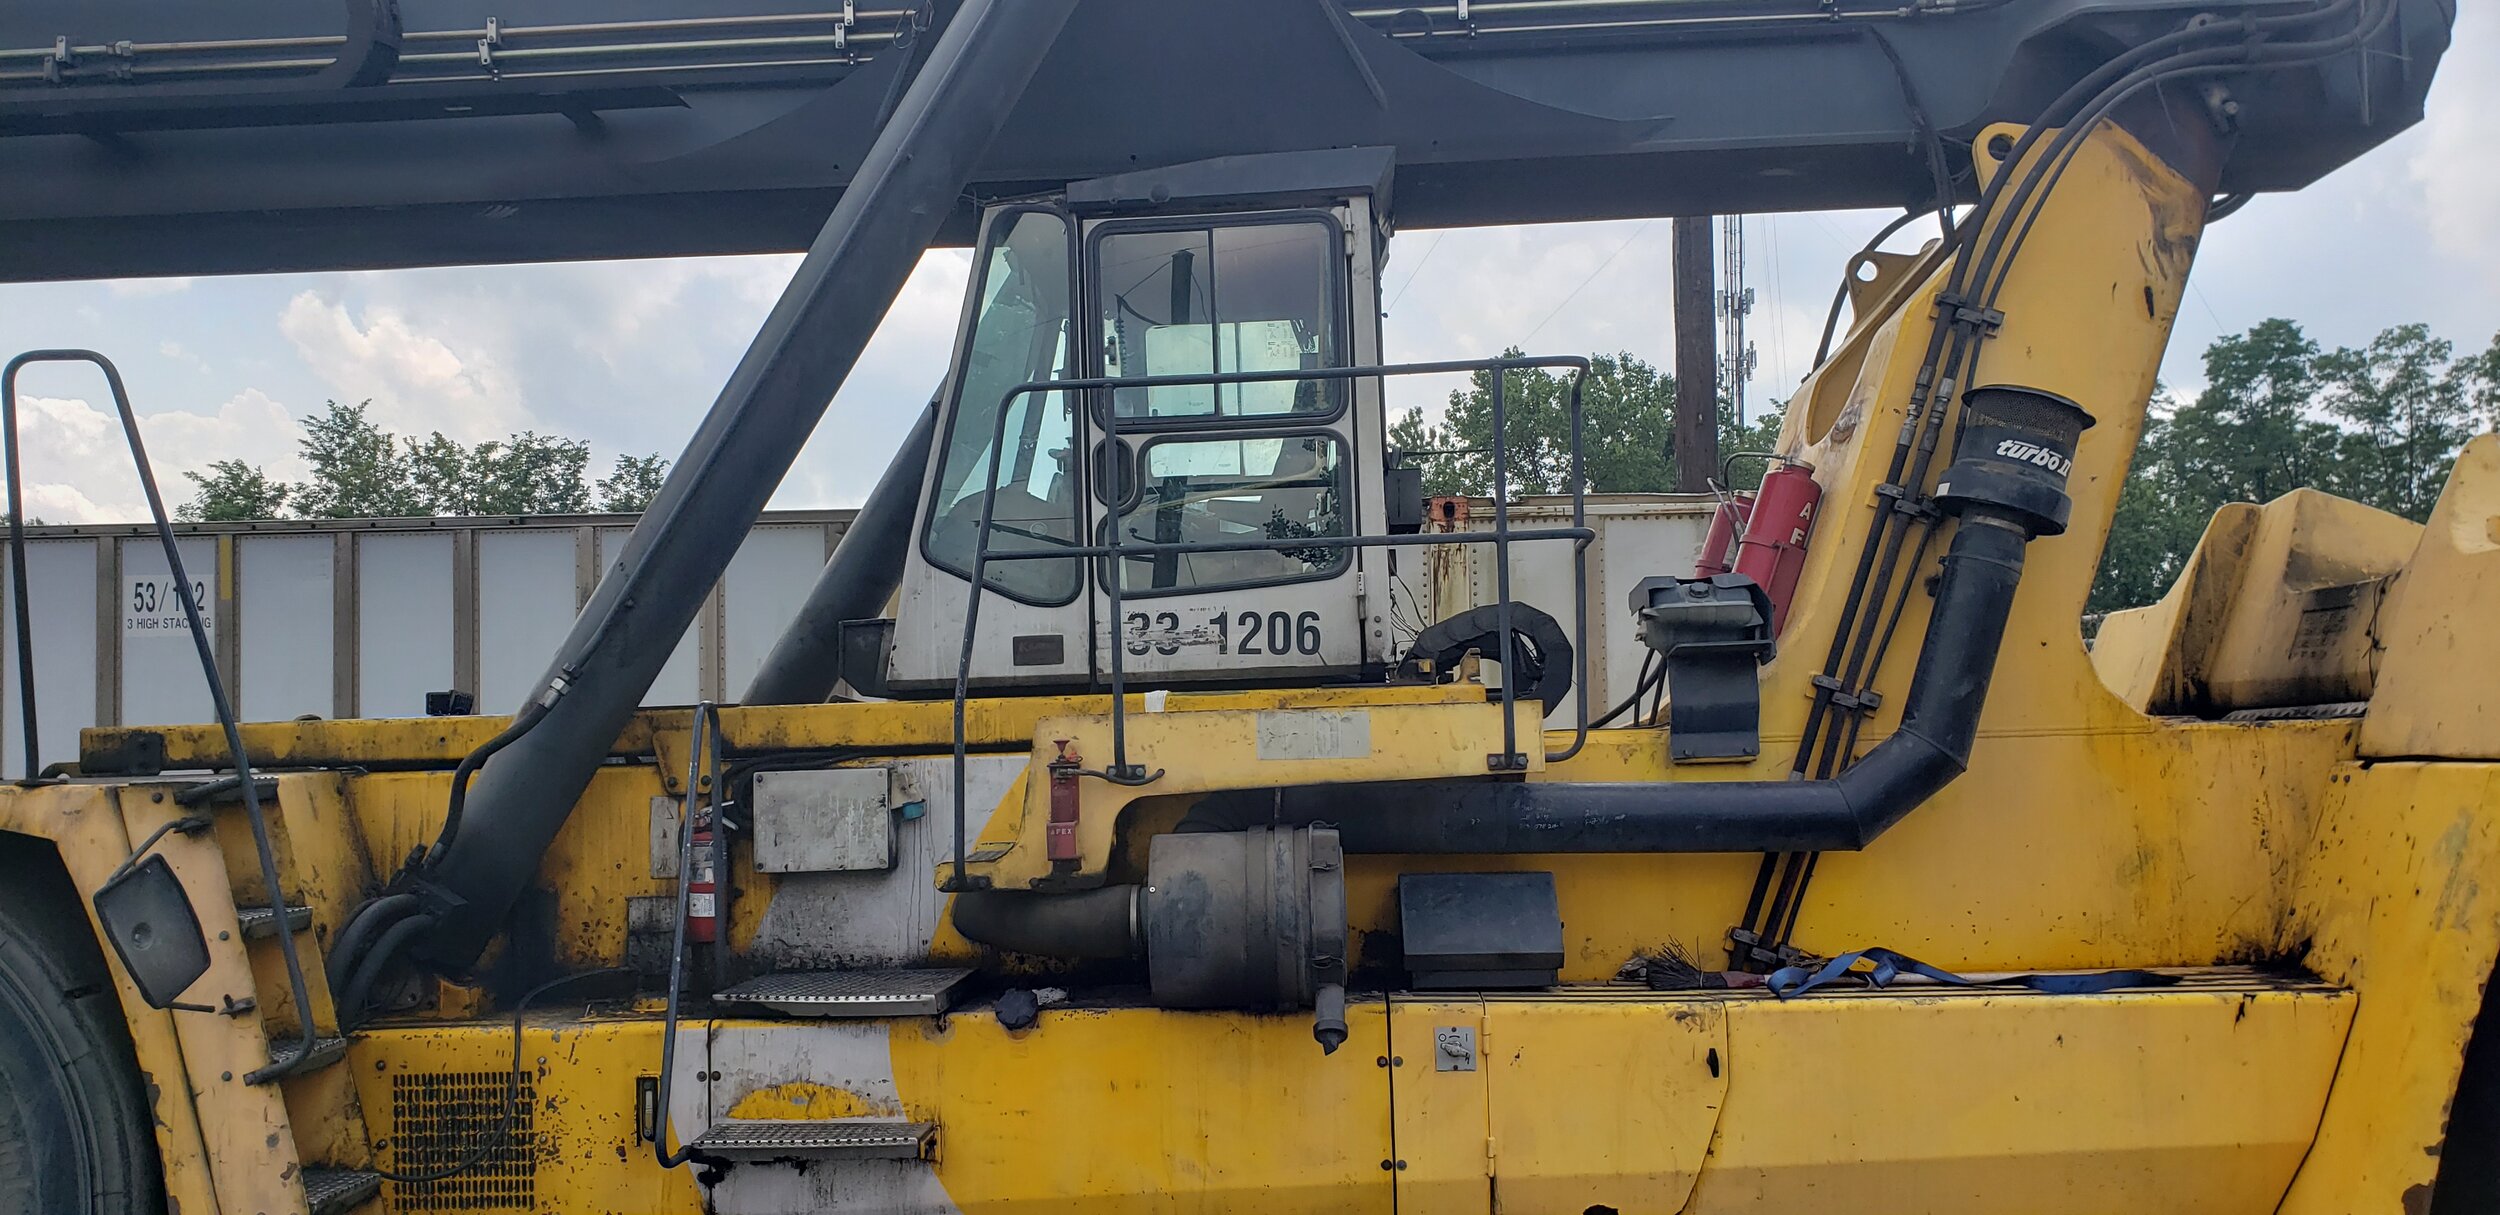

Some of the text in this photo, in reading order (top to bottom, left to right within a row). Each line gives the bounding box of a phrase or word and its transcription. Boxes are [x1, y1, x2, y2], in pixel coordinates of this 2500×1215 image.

[1996, 439, 2062, 471] turbo
[133, 581, 205, 613] 53/12
[127, 617, 211, 630] 3 HIGH STACG
